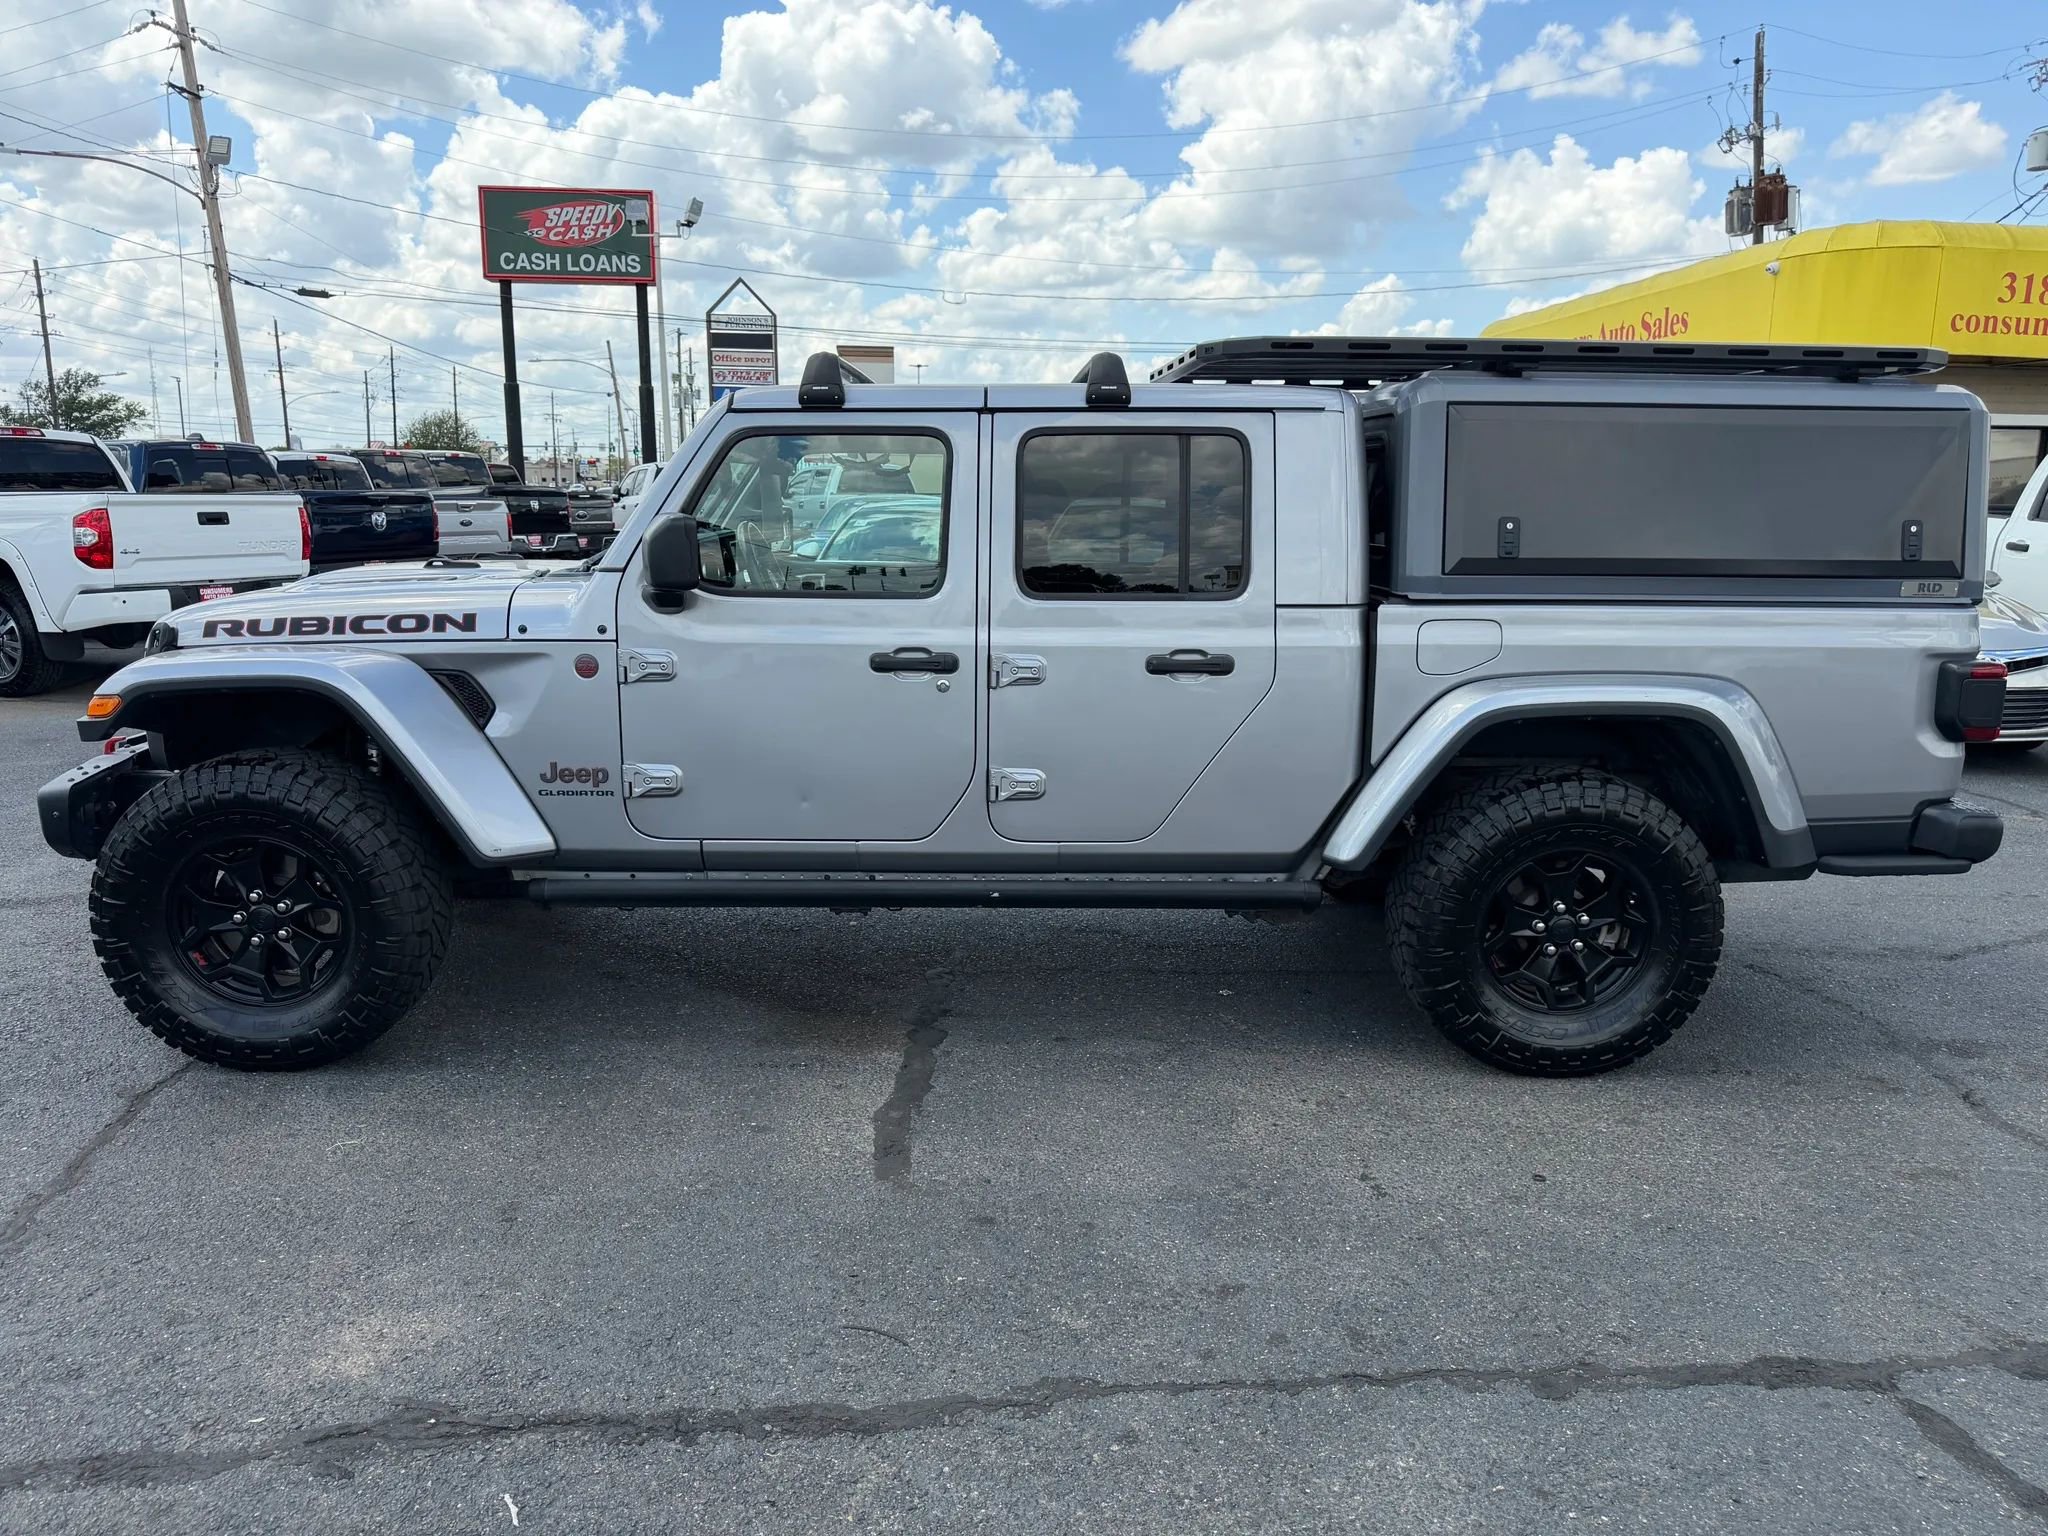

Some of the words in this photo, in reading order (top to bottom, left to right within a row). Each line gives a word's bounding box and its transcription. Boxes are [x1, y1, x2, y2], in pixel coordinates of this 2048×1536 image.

[543, 203, 621, 227] SPEEDY
[549, 223, 614, 241] CA$H
[500, 252, 560, 271] CASH
[567, 253, 641, 273] LOANS
[1599, 320, 1635, 341] Auto
[1640, 307, 1689, 341] Sales
[713, 354, 742, 363] Office
[200, 587, 234, 595] CONSUMERS
[202, 612, 477, 638] RUBICON
[539, 761, 609, 788] Jeep
[538, 789, 615, 797] GLADIATOR
